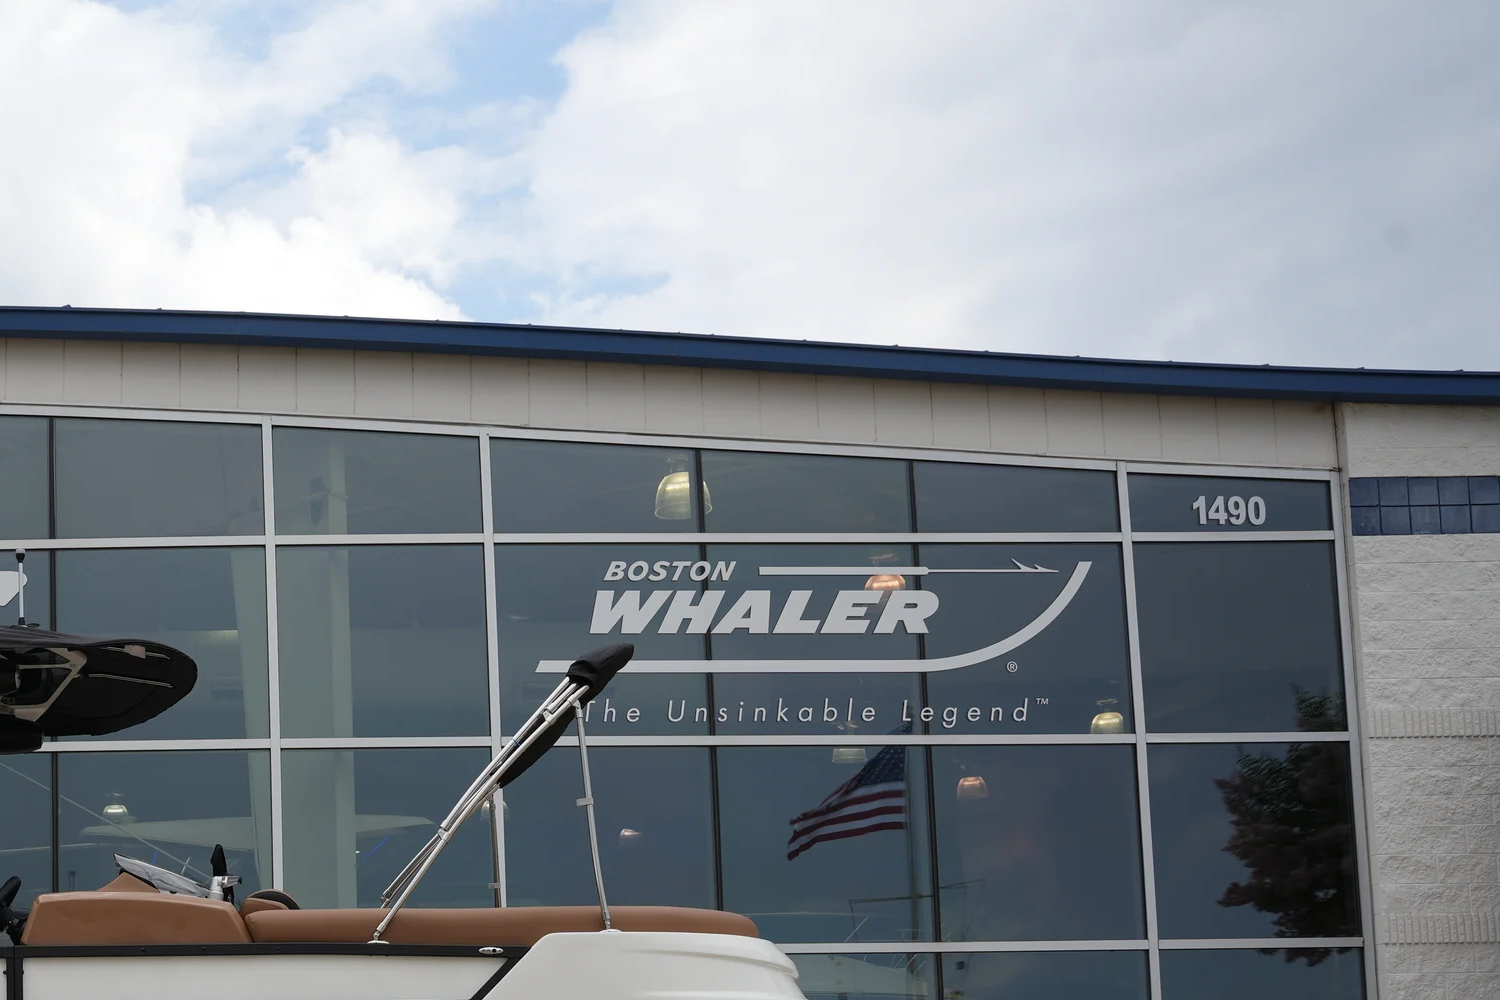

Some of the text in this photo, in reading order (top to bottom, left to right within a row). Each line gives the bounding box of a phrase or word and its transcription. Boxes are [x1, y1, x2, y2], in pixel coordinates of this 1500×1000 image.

[1193, 495, 1266, 525] 1490
[604, 560, 737, 582] BOSTON
[590, 588, 939, 635] WHALER
[585, 698, 641, 723] The
[668, 697, 876, 724] Unsinkable
